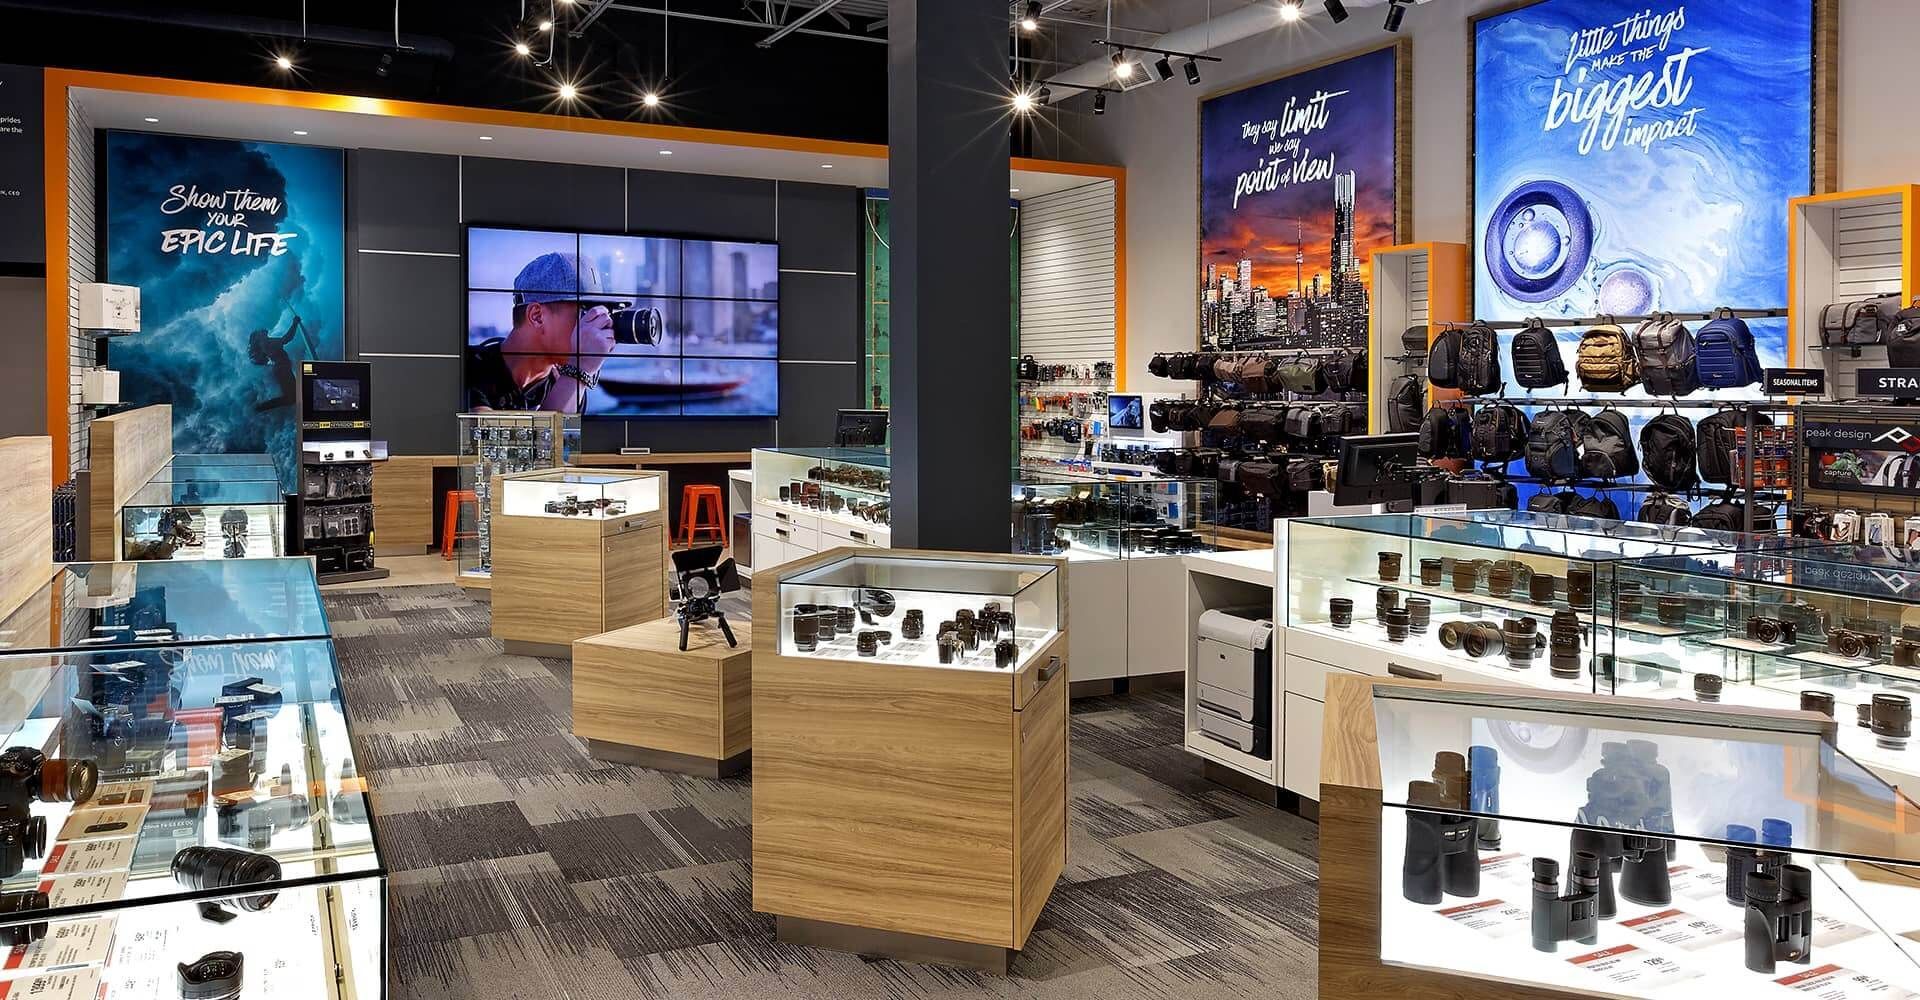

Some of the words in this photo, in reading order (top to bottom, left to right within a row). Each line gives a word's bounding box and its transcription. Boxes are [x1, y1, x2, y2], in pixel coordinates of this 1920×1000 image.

[1565, 27, 1618, 74] Little
[1612, 6, 1686, 52] things
[1590, 52, 1629, 72] MAKE
[1630, 45, 1659, 62] THE
[1544, 46, 1712, 156] biggest
[11, 126, 24, 134] the
[1242, 121, 1261, 145] they
[1261, 119, 1278, 140] say
[1280, 90, 1350, 138] limit
[1623, 107, 1705, 153] impact
[1268, 141, 1284, 155] we
[1283, 137, 1301, 158] say
[1233, 157, 1287, 209] point
[1280, 167, 1291, 188] of
[1292, 148, 1335, 184] view
[160, 184, 227, 214] Show
[224, 188, 281, 215] them
[206, 210, 248, 228] YOUR
[161, 229, 227, 253] EPIC
[230, 229, 298, 257] LIFE
[1772, 378, 1801, 386] SEASONAL
[1801, 378, 1818, 387] ITEMS
[1878, 377, 1919, 388] STRA
[1806, 428, 1832, 438] peak
[1834, 428, 1872, 441] design
[1824, 469, 1852, 477] capture
